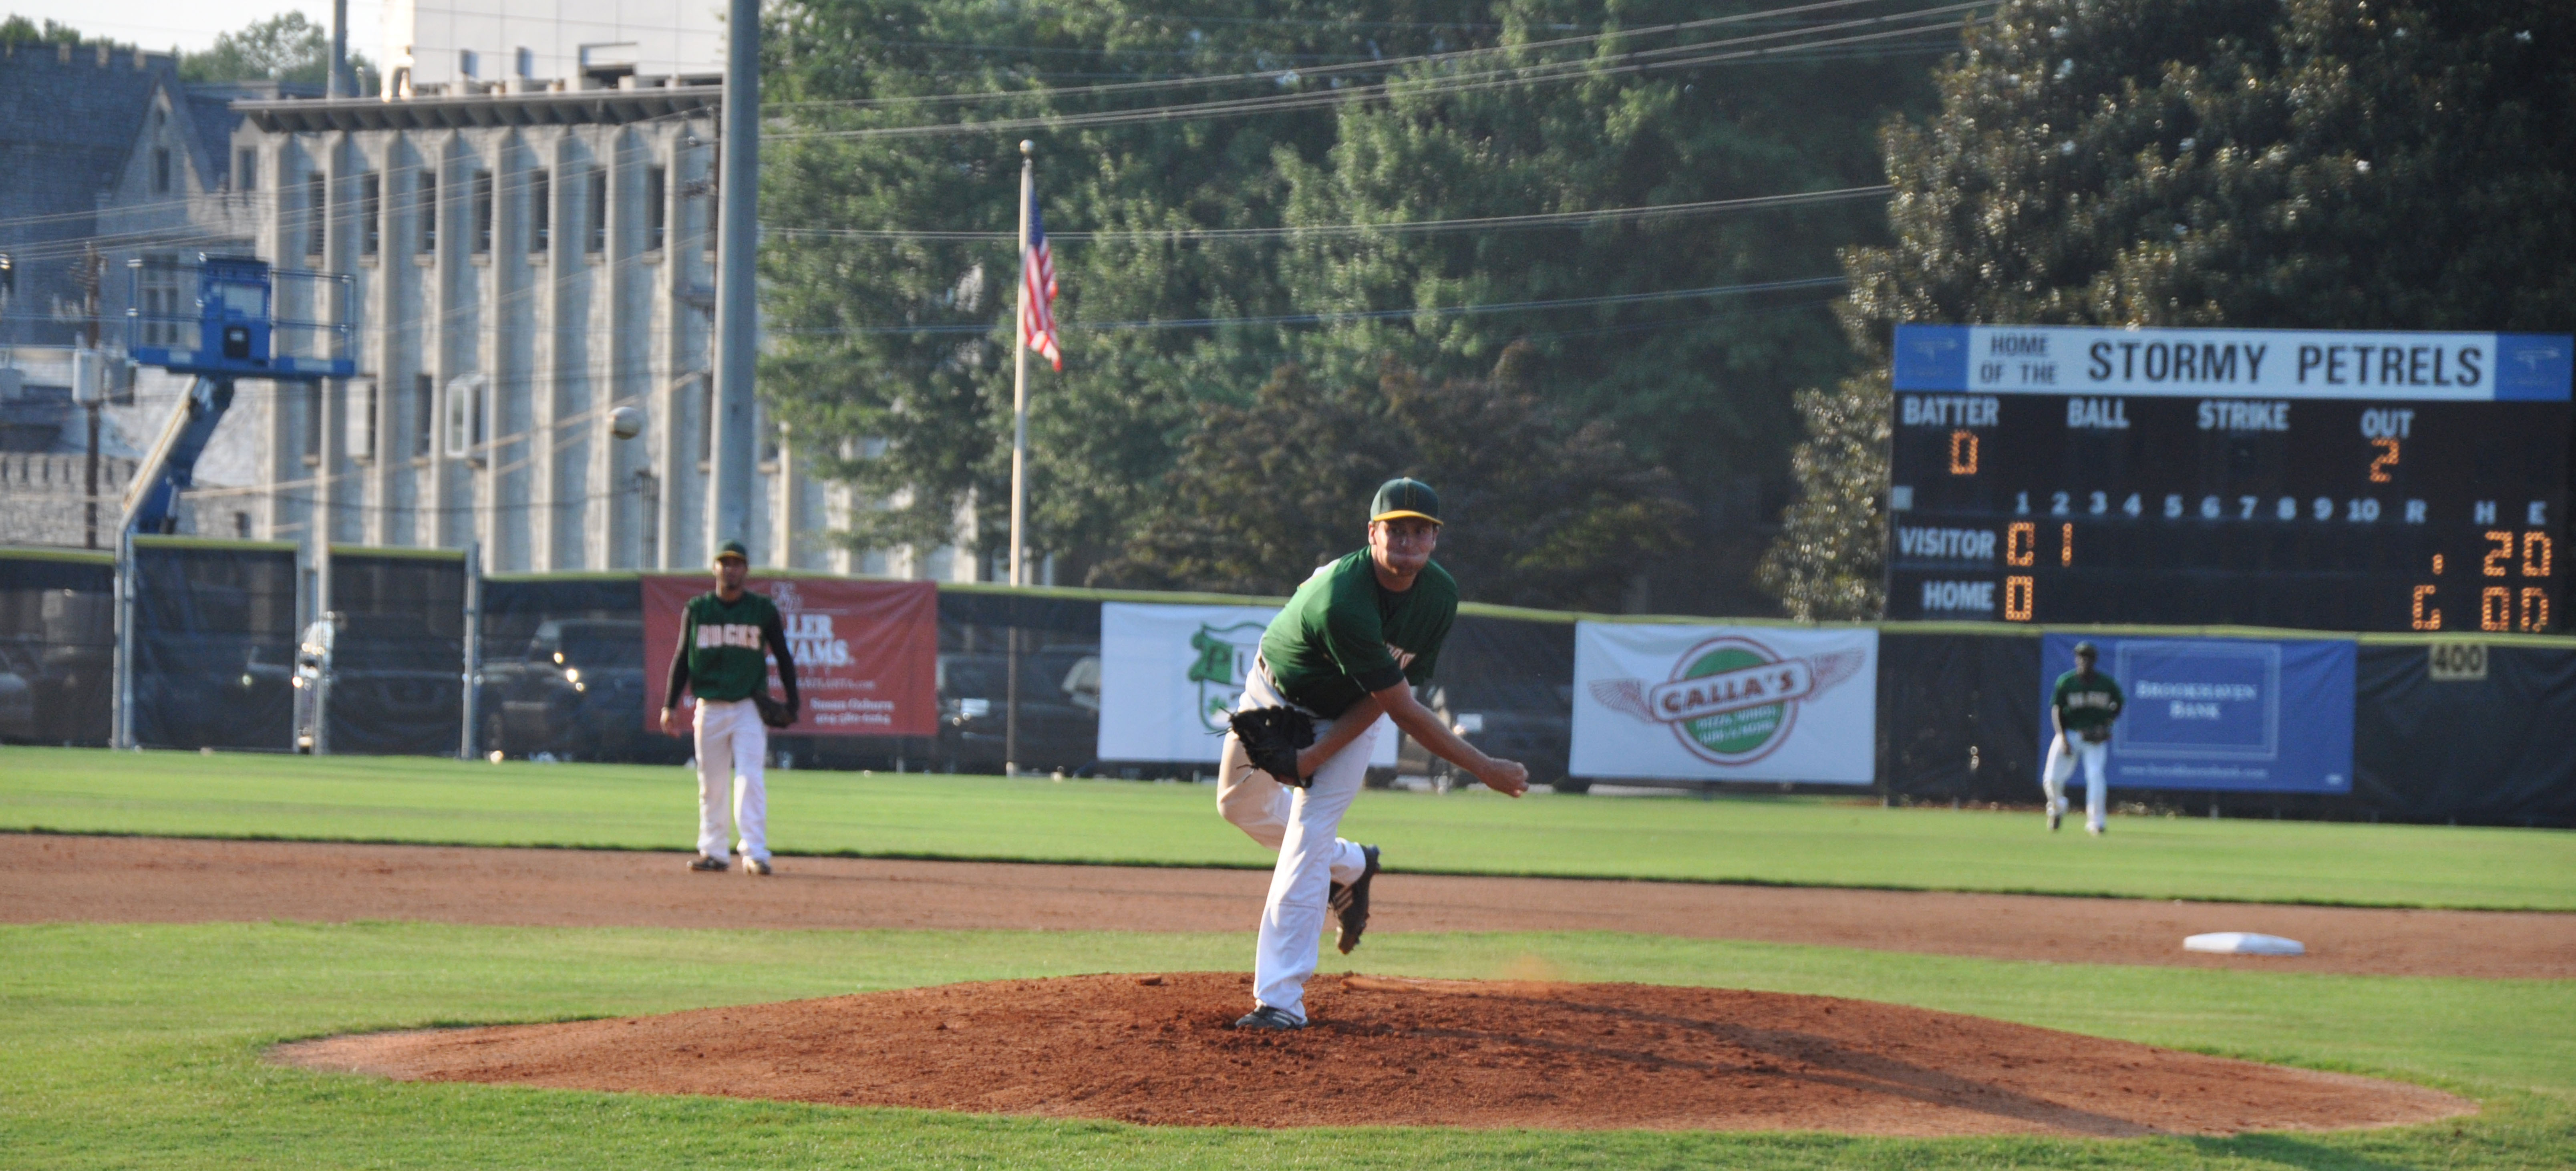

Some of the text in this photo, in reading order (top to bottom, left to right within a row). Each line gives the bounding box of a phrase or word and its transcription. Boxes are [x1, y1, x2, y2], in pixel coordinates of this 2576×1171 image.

[1990, 333, 2049, 356] HOME
[1980, 360, 2059, 384] OF THE
[2088, 341, 2482, 387] STORMY PETRELS
[1903, 396, 1999, 427] BATTER
[2067, 399, 2131, 429] BALL
[2196, 400, 2290, 431] STRIKE
[2360, 408, 2414, 439] OUT
[2369, 437, 2400, 483] 2
[2015, 491, 2547, 525] 1 2 3 4 5 6 7 8 9 10 R H E
[1899, 526, 1996, 559] VISITOR
[1923, 580, 1995, 611] HOME
[697, 623, 761, 650] BUCKS
[783, 614, 835, 640] LER
[2432, 645, 2483, 673] 400
[2135, 680, 2258, 700] BROOKHAVEN
[2169, 700, 2220, 720] BANK
